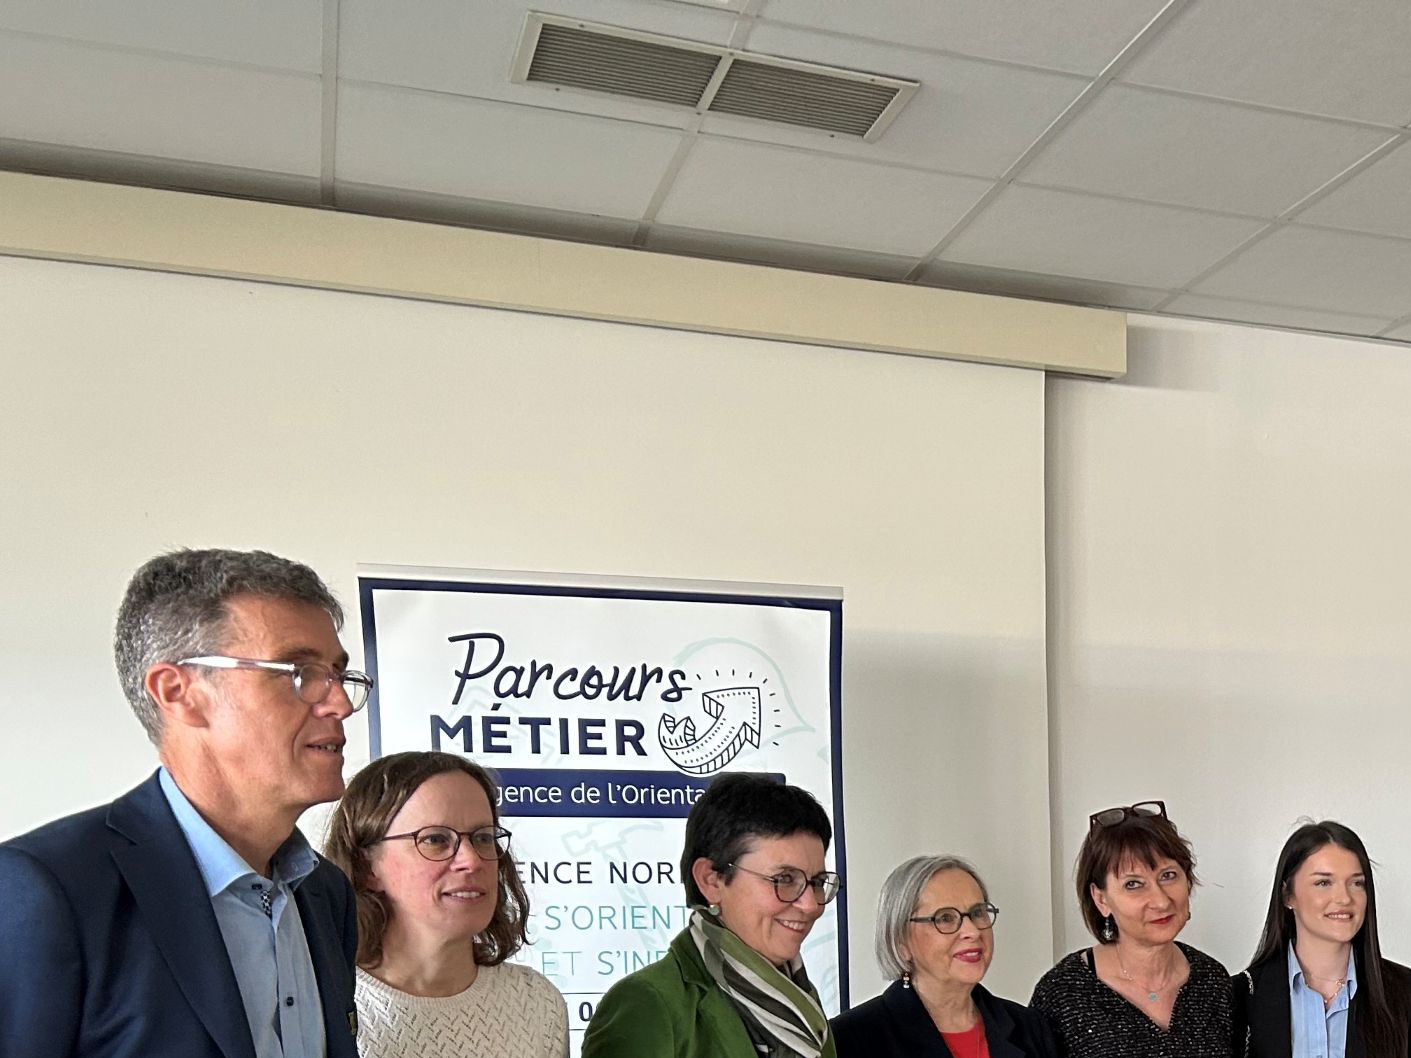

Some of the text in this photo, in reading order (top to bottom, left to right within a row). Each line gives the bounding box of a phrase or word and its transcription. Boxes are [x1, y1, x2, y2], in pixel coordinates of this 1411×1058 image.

[448, 632, 693, 705] Parcours
[430, 702, 648, 757] MÉTIER
[495, 783, 562, 808] gence
[571, 782, 601, 803] de
[516, 861, 685, 884] ENCE NOR
[544, 905, 688, 930] S'ORIENT
[542, 951, 582, 976] ET
